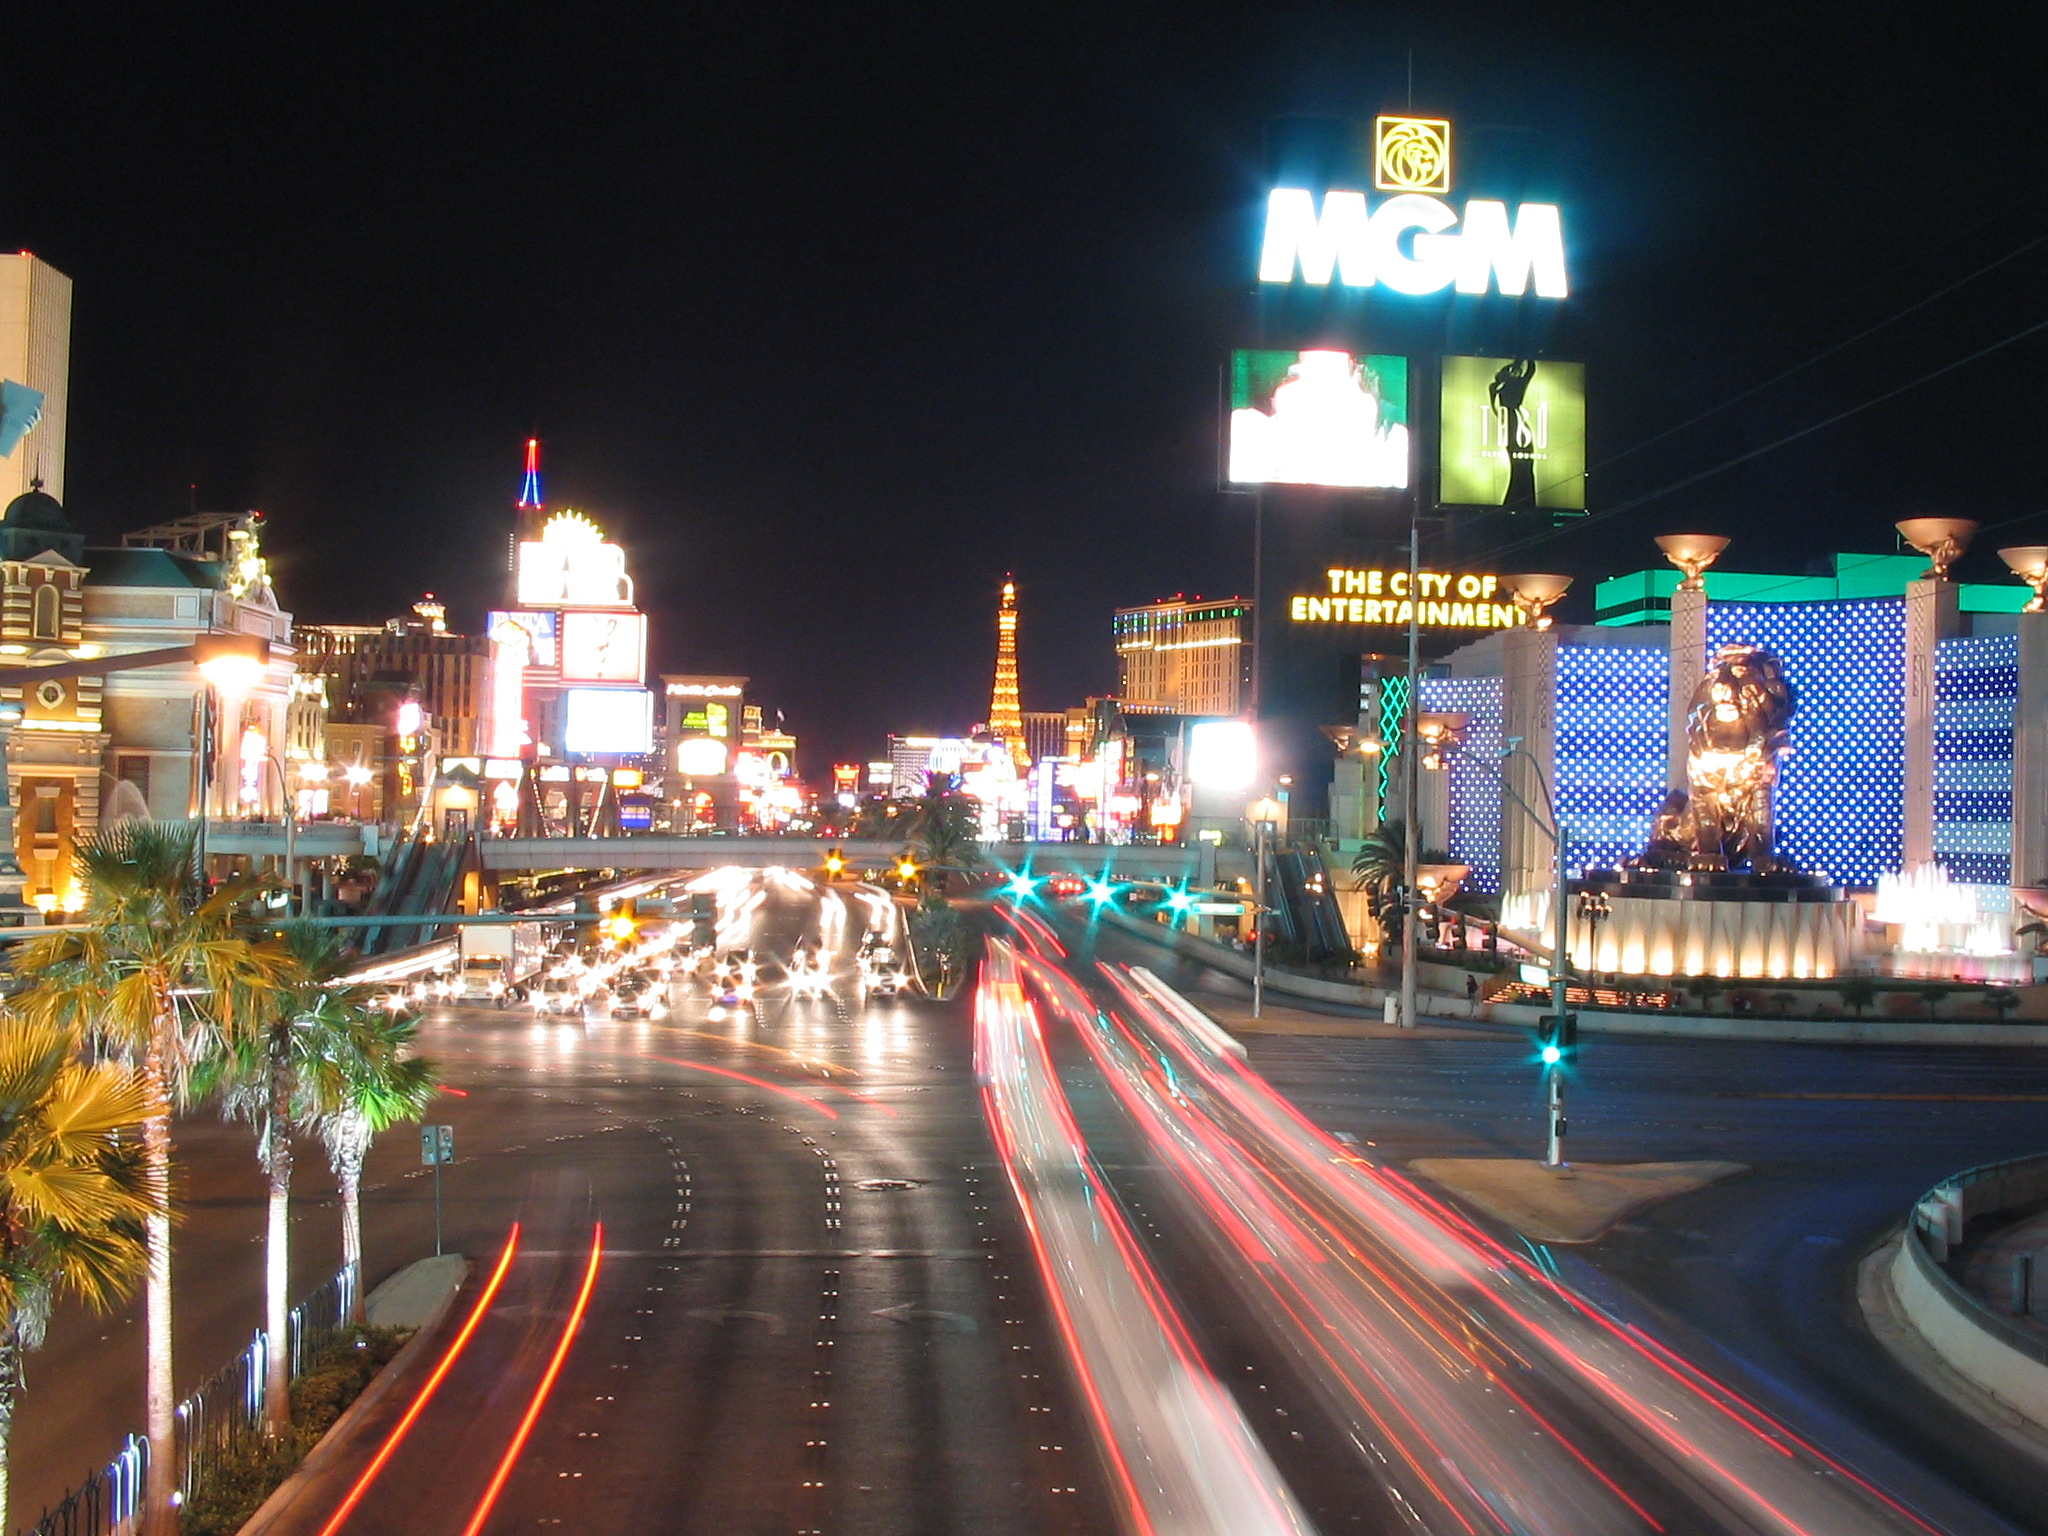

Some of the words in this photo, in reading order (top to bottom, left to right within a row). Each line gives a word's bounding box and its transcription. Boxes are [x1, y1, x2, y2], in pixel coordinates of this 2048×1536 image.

[1258, 187, 1568, 299] MGM
[1327, 569, 1383, 595] THE
[1457, 574, 1497, 600] OF
[1291, 596, 1527, 629] ENTERTAINMENT
